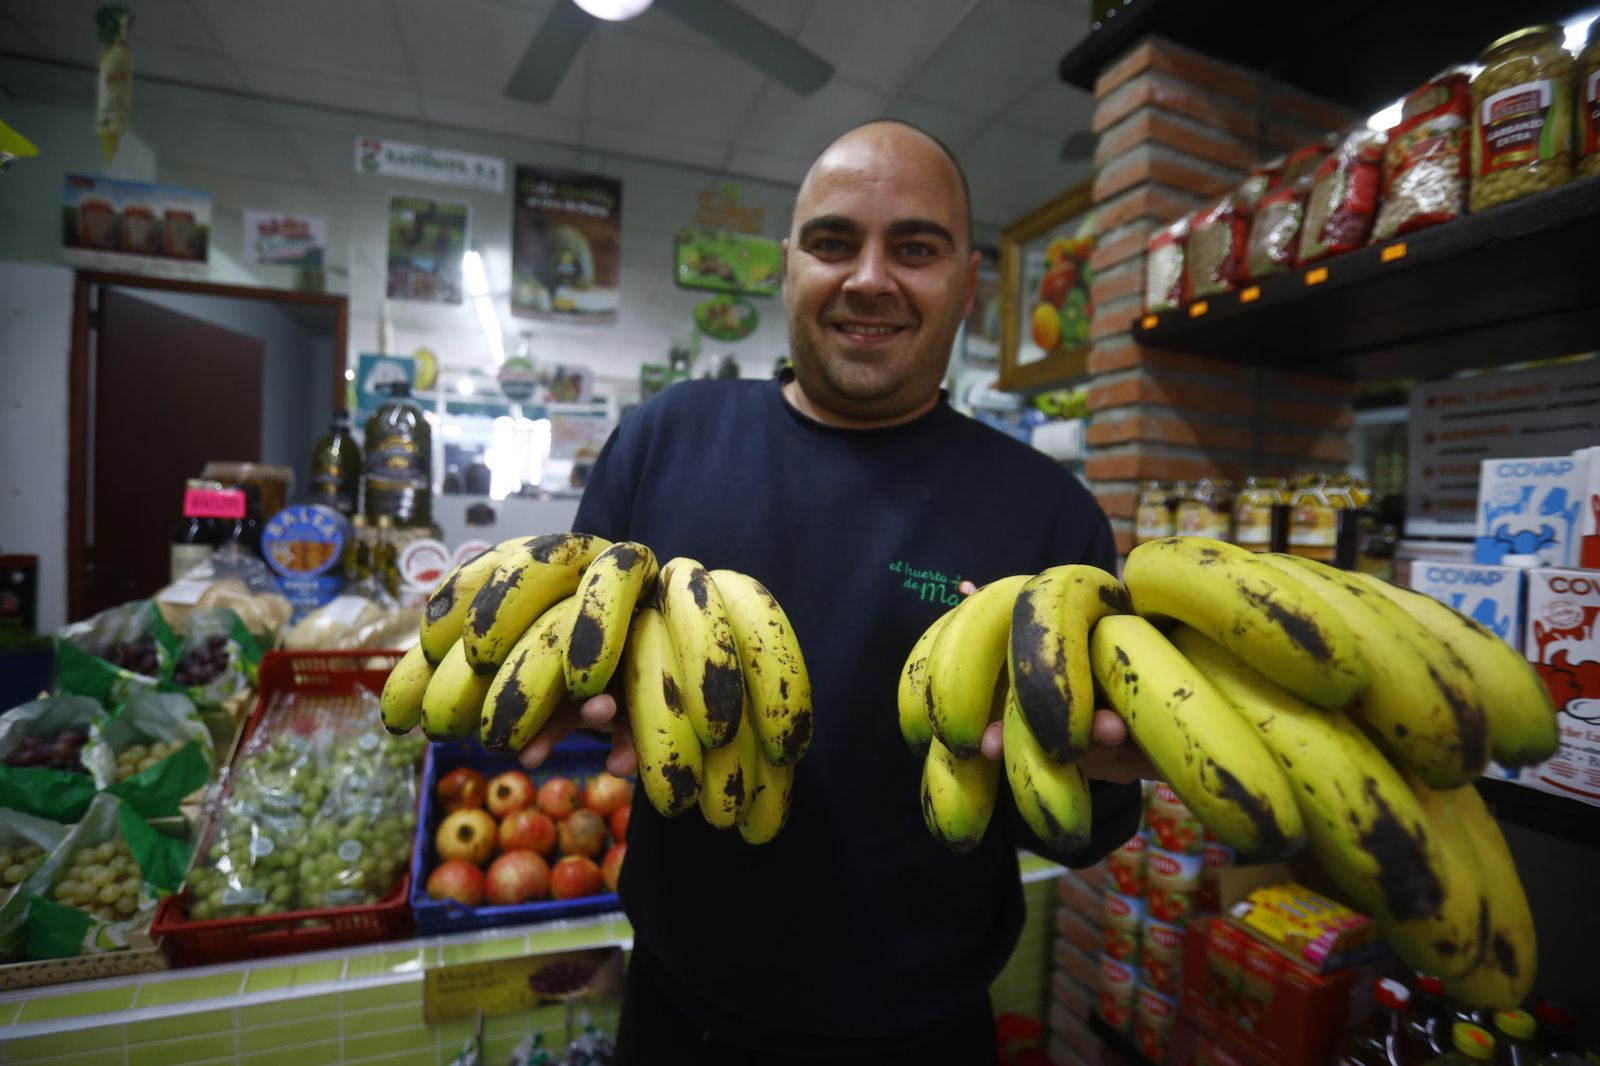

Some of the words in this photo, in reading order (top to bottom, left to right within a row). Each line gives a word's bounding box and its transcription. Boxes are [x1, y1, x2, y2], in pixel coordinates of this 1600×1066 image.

[1496, 461, 1574, 477] COVAP
[889, 560, 903, 572] el
[905, 562, 948, 583] huerto
[1427, 566, 1503, 586] COVAP
[903, 577, 919, 589] de
